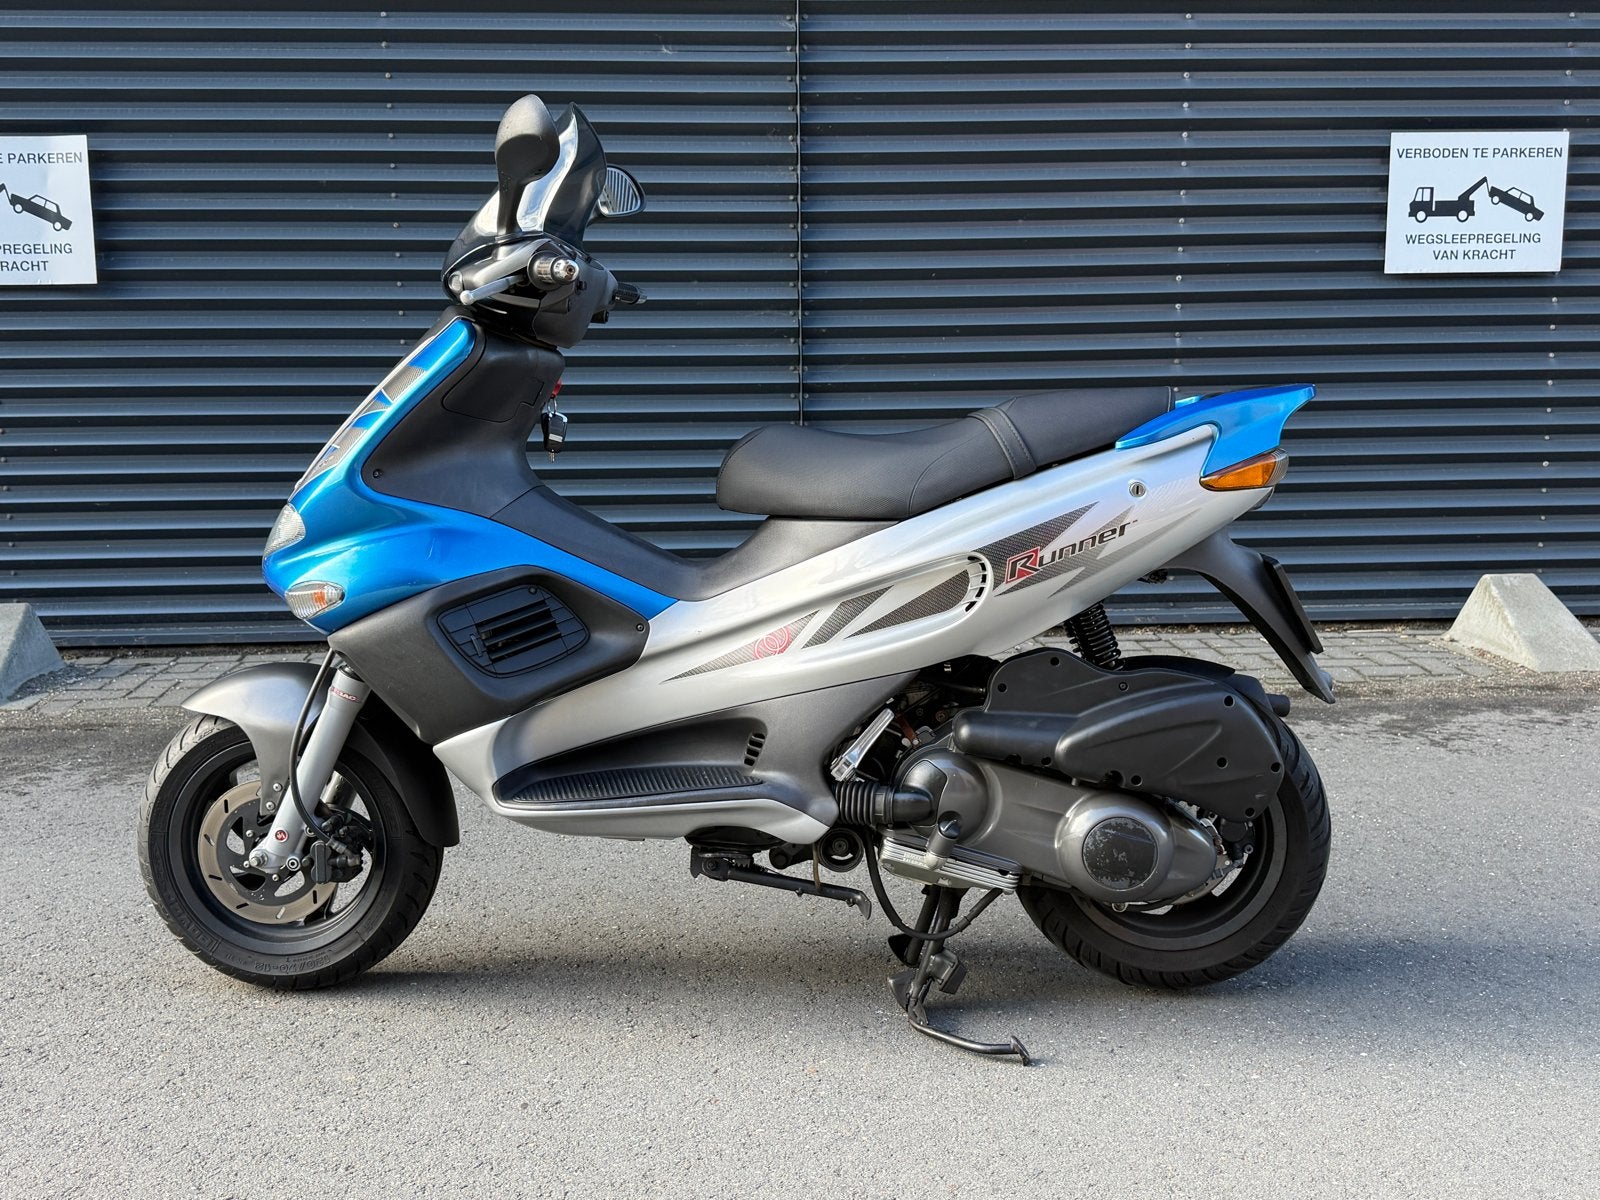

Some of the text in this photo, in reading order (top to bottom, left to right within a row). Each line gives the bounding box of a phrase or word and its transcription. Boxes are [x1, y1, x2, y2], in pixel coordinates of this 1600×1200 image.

[7, 152, 83, 165] PARKEREN
[1396, 147, 1563, 159] VERBODEN TE PARKEREN
[1405, 233, 1541, 245] WEGSLEEPREGELING
[0, 243, 73, 255] REGELING
[1433, 249, 1516, 260] VAN KRACHT
[1005, 520, 1131, 582] Runner
